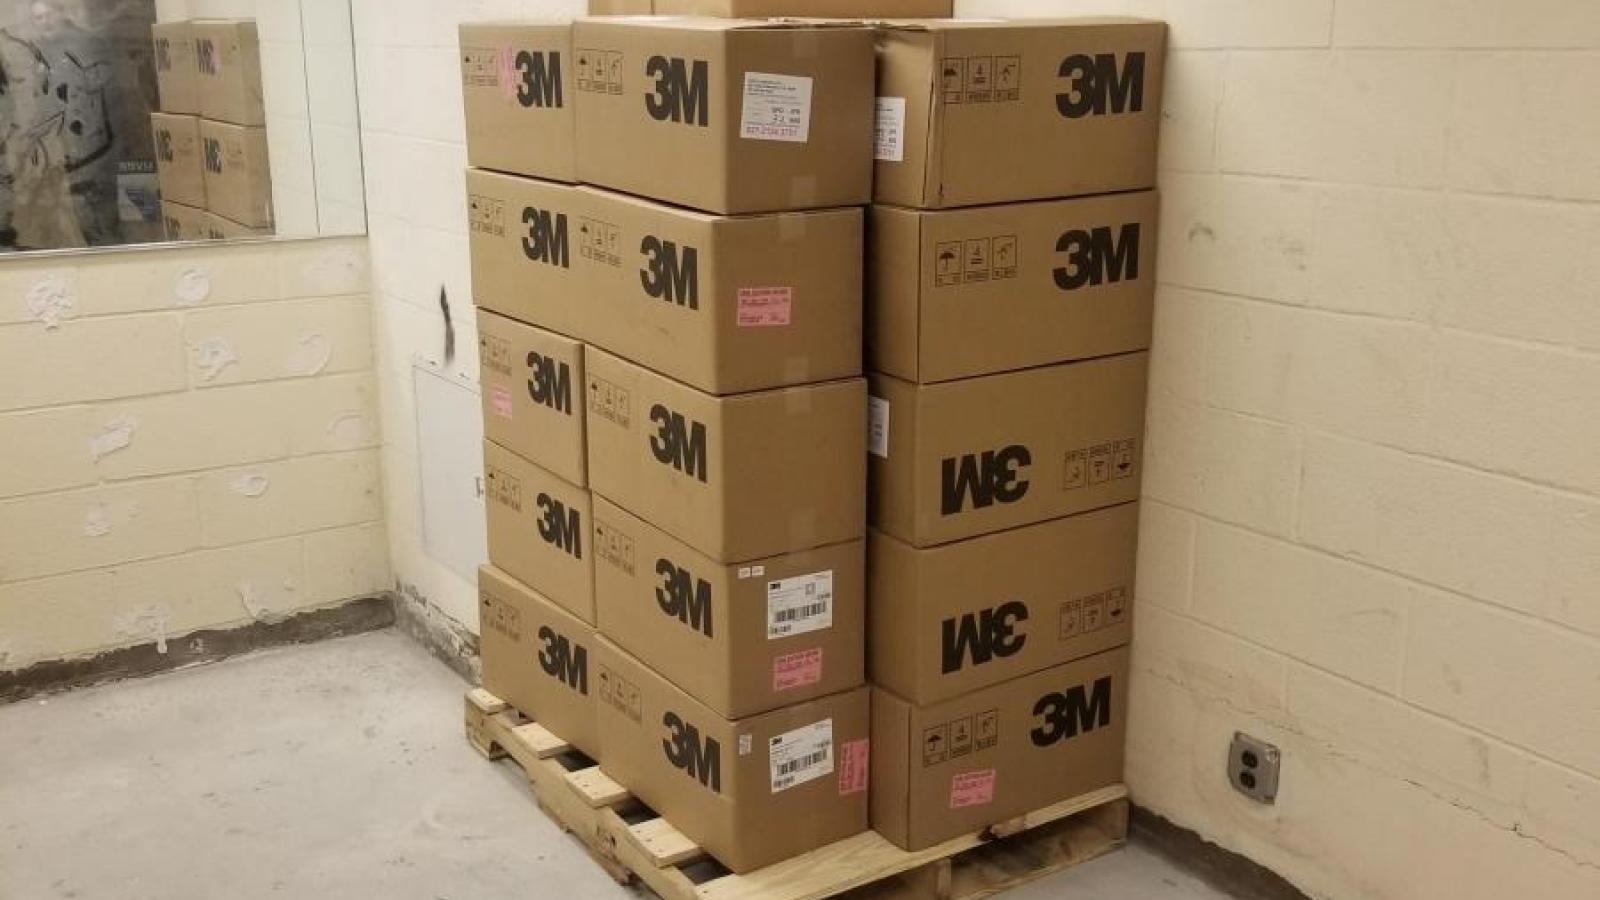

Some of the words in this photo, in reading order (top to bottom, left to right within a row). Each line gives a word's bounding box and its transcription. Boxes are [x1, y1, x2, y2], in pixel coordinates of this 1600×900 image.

[516, 50, 562, 108] 3M
[645, 55, 708, 127] 3M
[1056, 52, 1145, 118] 3M
[522, 206, 569, 268] 3M
[1053, 223, 1140, 290] 3M
[640, 235, 700, 310] 3M
[527, 351, 571, 415] 3M
[650, 403, 707, 483] 3M
[941, 445, 1031, 515] 3M
[537, 493, 582, 559] 3M
[656, 559, 713, 638] 3M
[538, 626, 588, 695] 3M
[942, 602, 1028, 675] 3M
[1031, 676, 1112, 746] 3M
[663, 711, 721, 793] 3M
